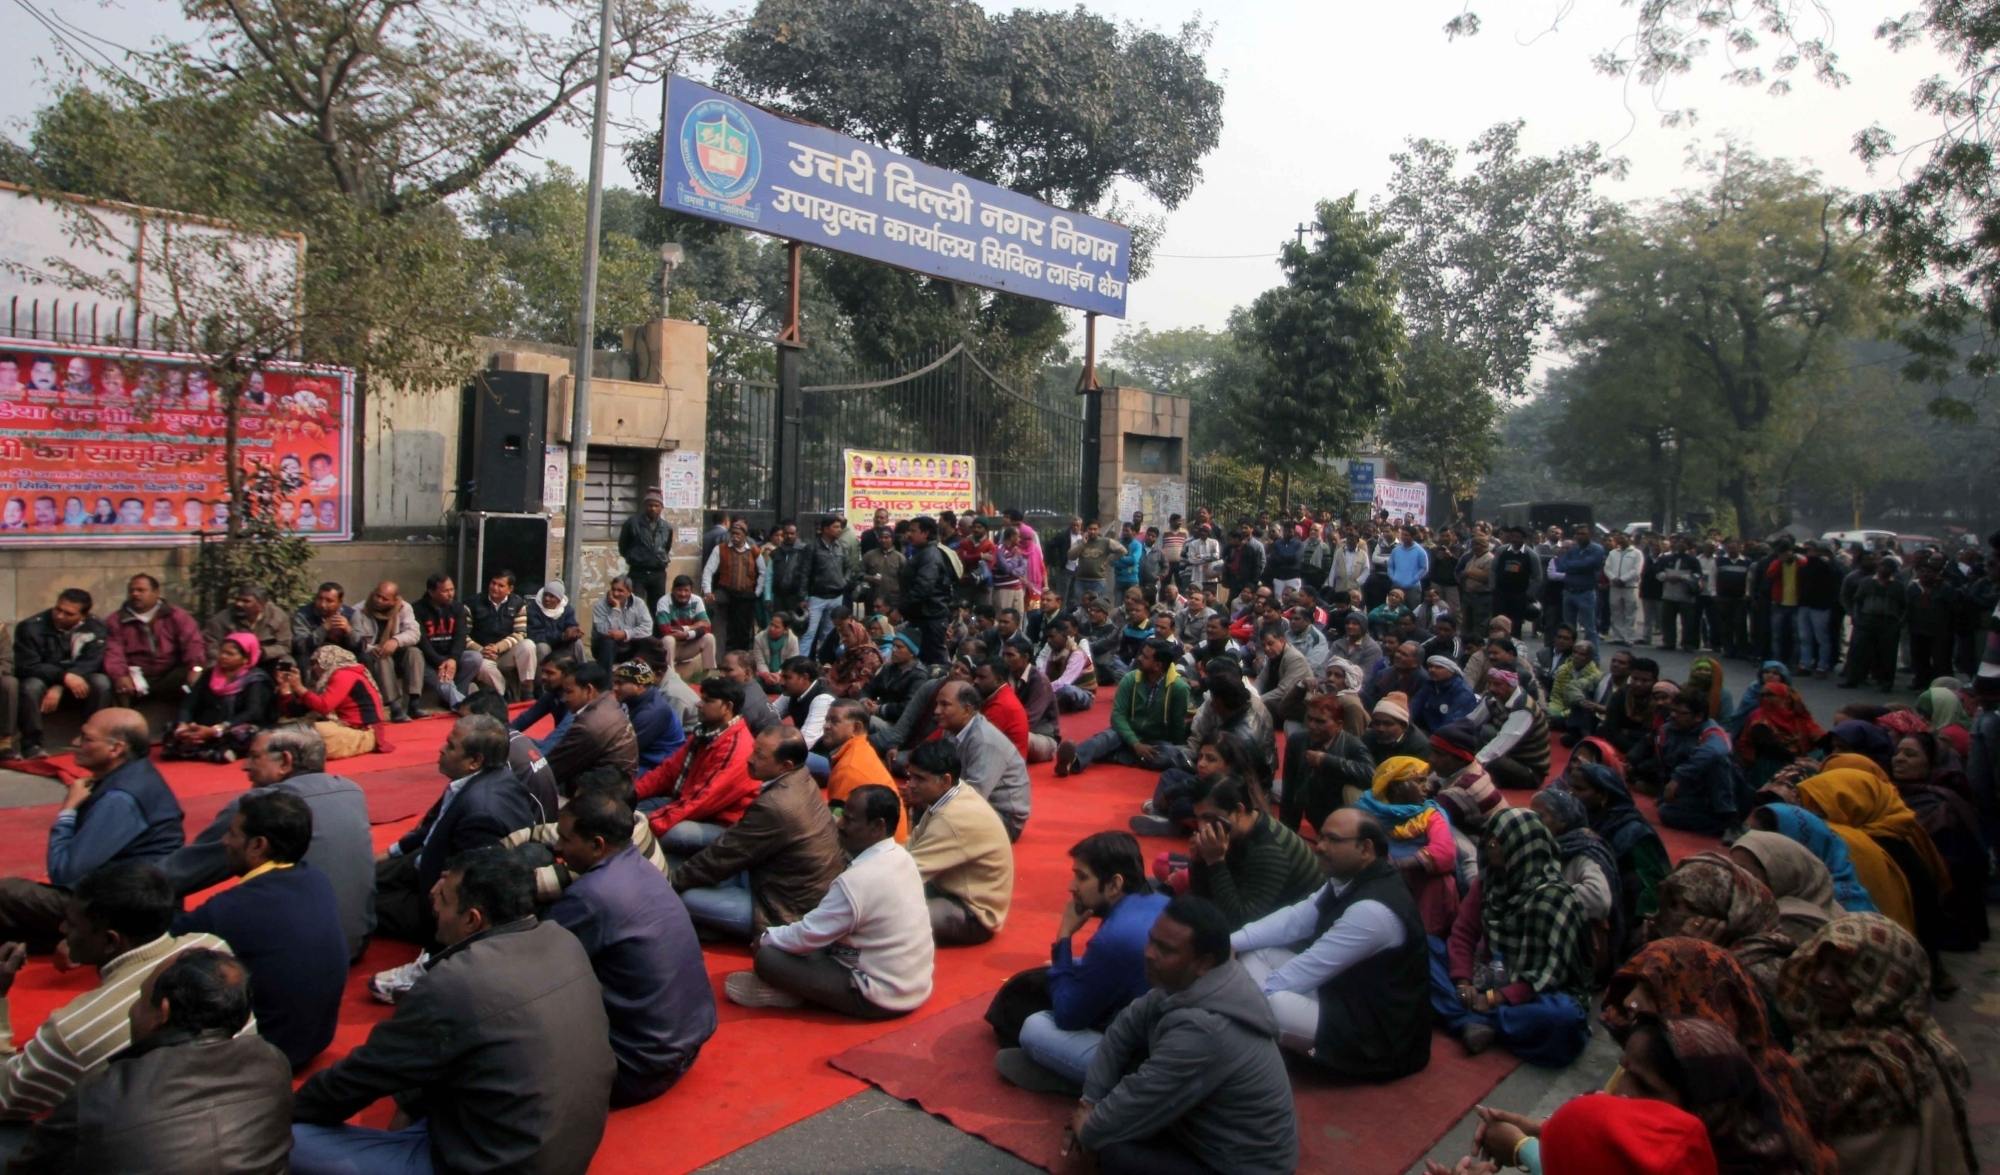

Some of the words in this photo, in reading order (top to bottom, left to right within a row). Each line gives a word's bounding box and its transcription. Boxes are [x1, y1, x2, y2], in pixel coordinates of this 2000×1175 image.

[771, 184, 878, 237] उपायुक्त
[883, 216, 976, 262] कार्यालय
[981, 236, 1044, 280] सिविल
[1046, 261, 1095, 293] लाईन
[1098, 270, 1125, 300] क्षेत्र
[788, 141, 876, 196] उत्तरी
[883, 161, 974, 225] दिल्ली
[980, 202, 1046, 246] नगर
[1050, 215, 1119, 267] निगम
[851, 496, 914, 511] विशाल
[919, 496, 971, 512] प्रदर्शन
